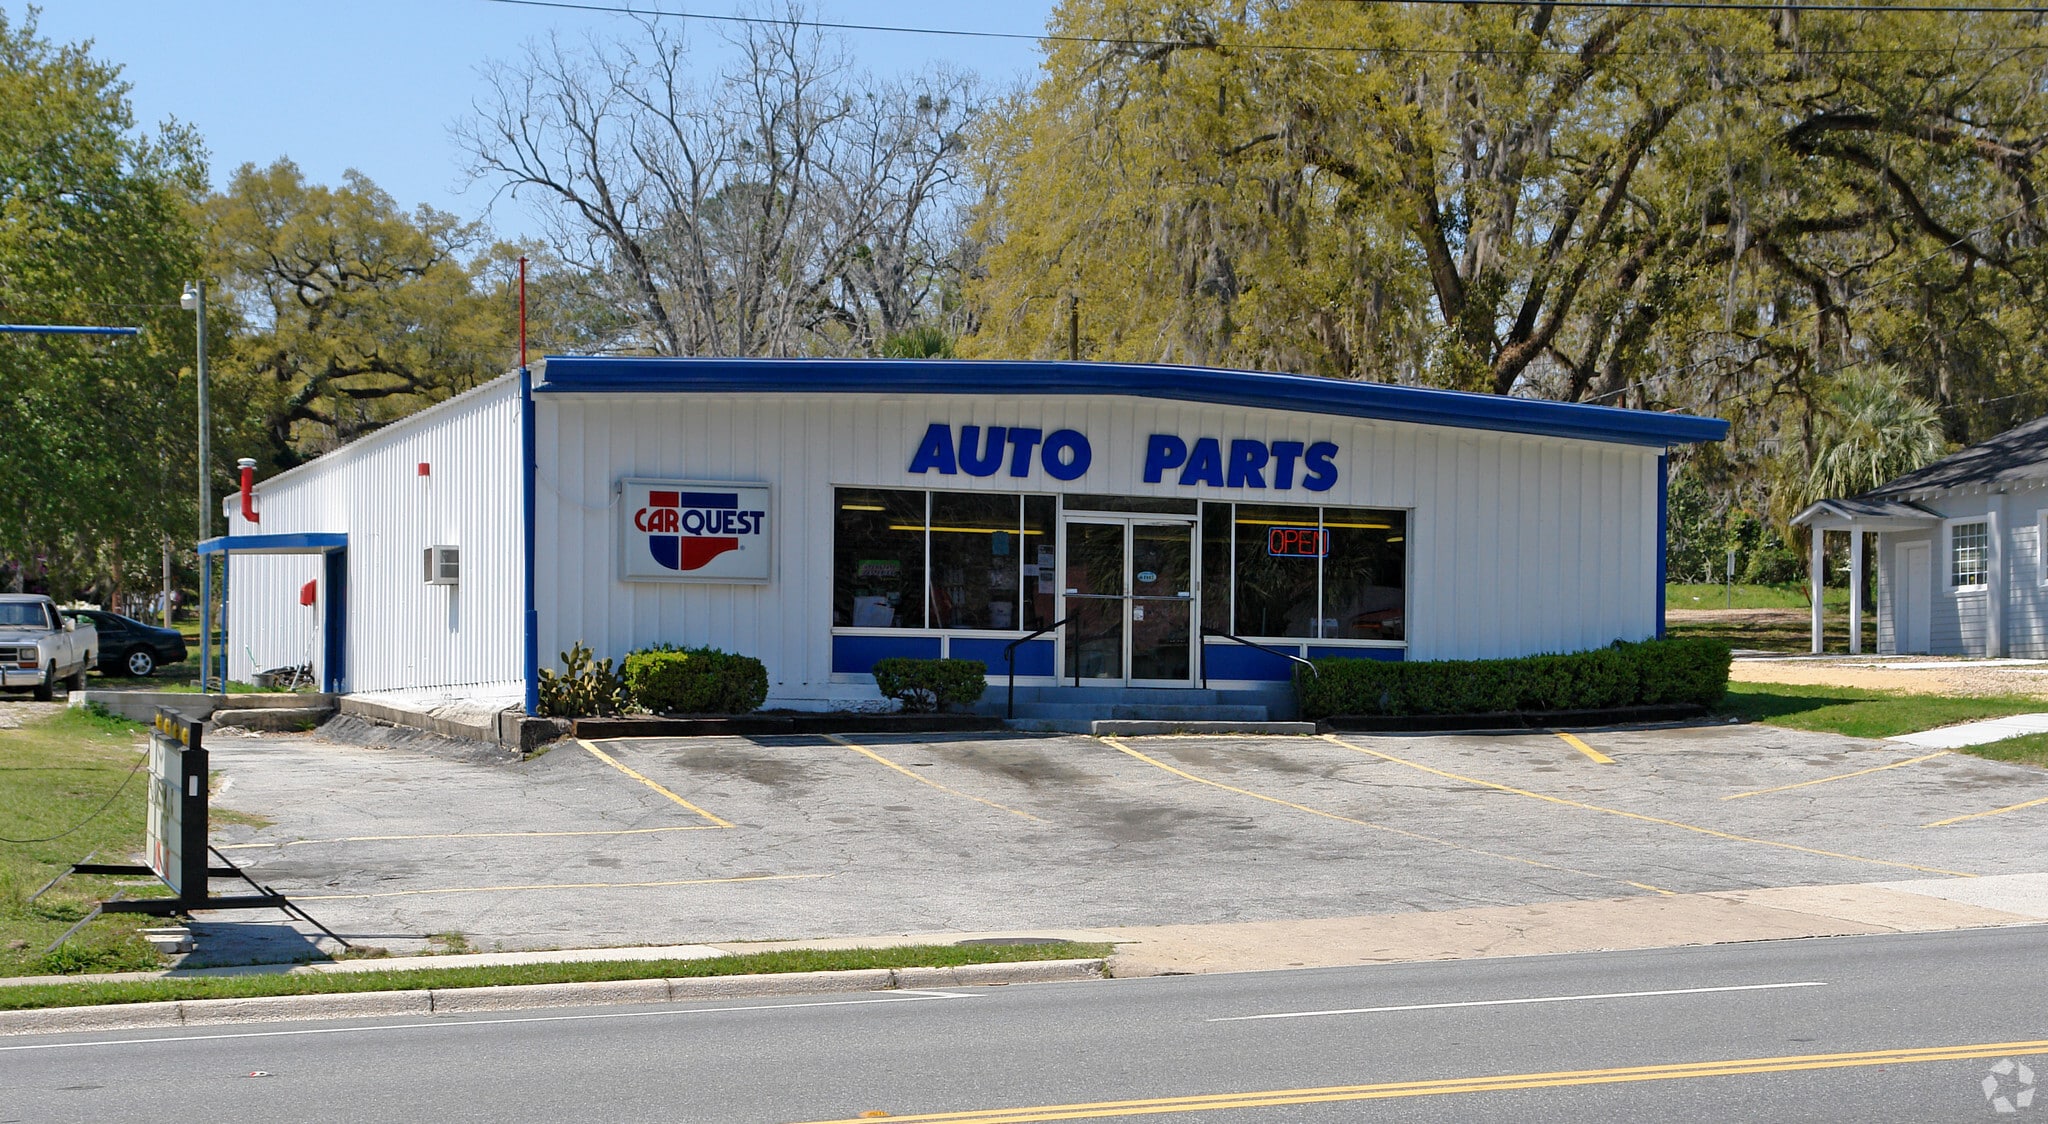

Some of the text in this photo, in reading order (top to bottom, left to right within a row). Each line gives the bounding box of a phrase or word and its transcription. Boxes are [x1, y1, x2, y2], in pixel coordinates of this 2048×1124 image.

[908, 424, 1339, 491] AUTO PARTS
[1270, 529, 1328, 555] OPEN
